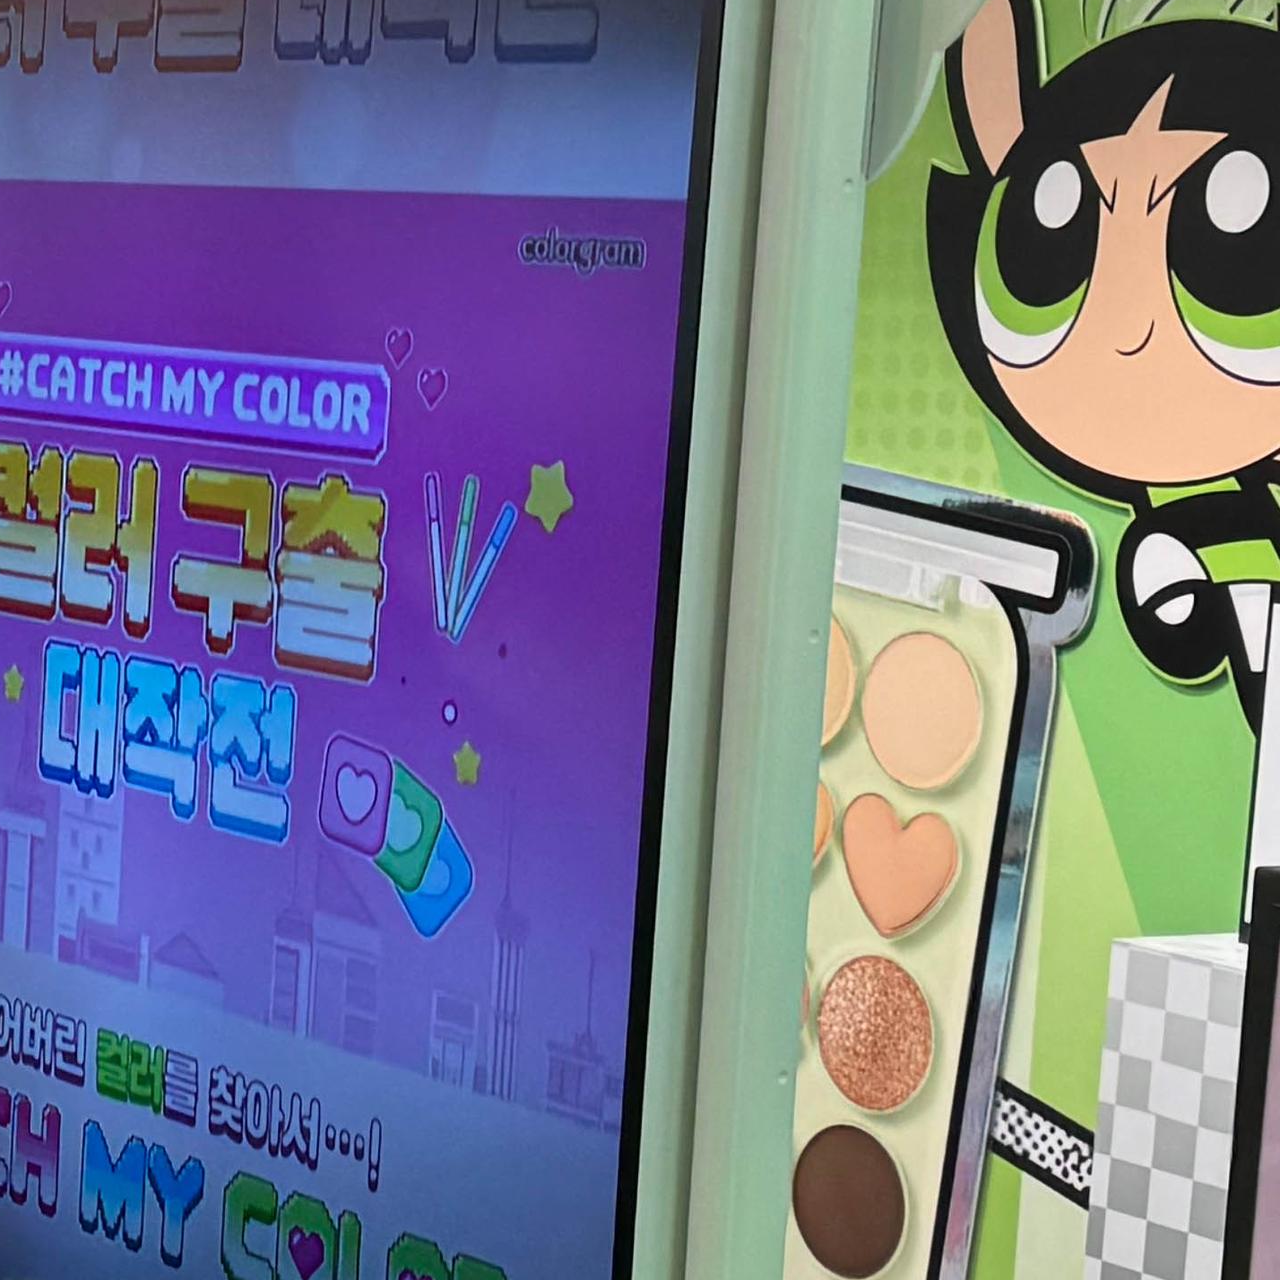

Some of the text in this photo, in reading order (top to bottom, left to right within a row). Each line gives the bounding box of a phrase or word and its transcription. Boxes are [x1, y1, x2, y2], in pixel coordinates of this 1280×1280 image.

[519, 231, 647, 275] colorgram
[160, 365, 226, 417] MY
[231, 371, 372, 436] COLOR
[171, 466, 388, 683] 구출
[39, 641, 298, 845] 대작전
[95, 1027, 201, 1128] 컬러를
[78, 1118, 206, 1268] MY
